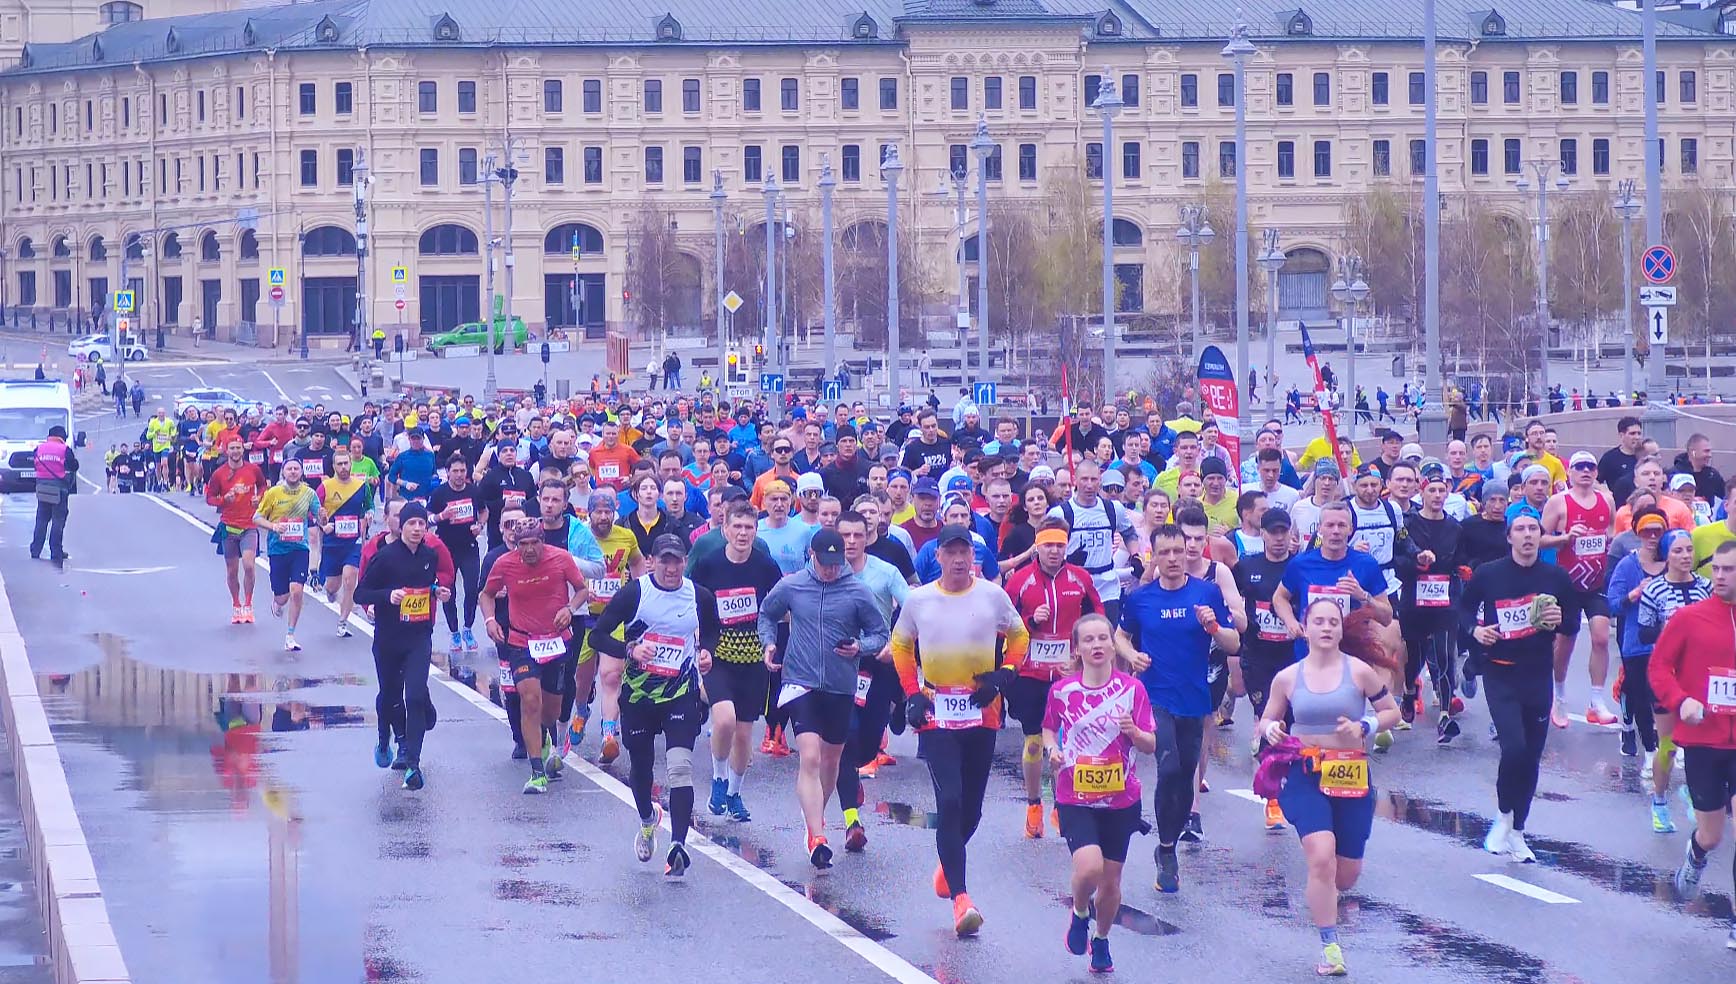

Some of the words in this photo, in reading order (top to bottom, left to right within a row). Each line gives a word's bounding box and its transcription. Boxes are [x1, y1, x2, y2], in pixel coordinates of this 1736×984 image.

[1580, 537, 1603, 549] 9858
[1420, 583, 1446, 597] 7454
[404, 597, 427, 609] 4687
[722, 596, 752, 611] 3600
[1503, 605, 1532, 623] 963
[533, 641, 559, 653] 6741
[1036, 642, 1066, 656] 7977
[1077, 767, 1122, 784] 15371
[1328, 764, 1361, 780] 4841
